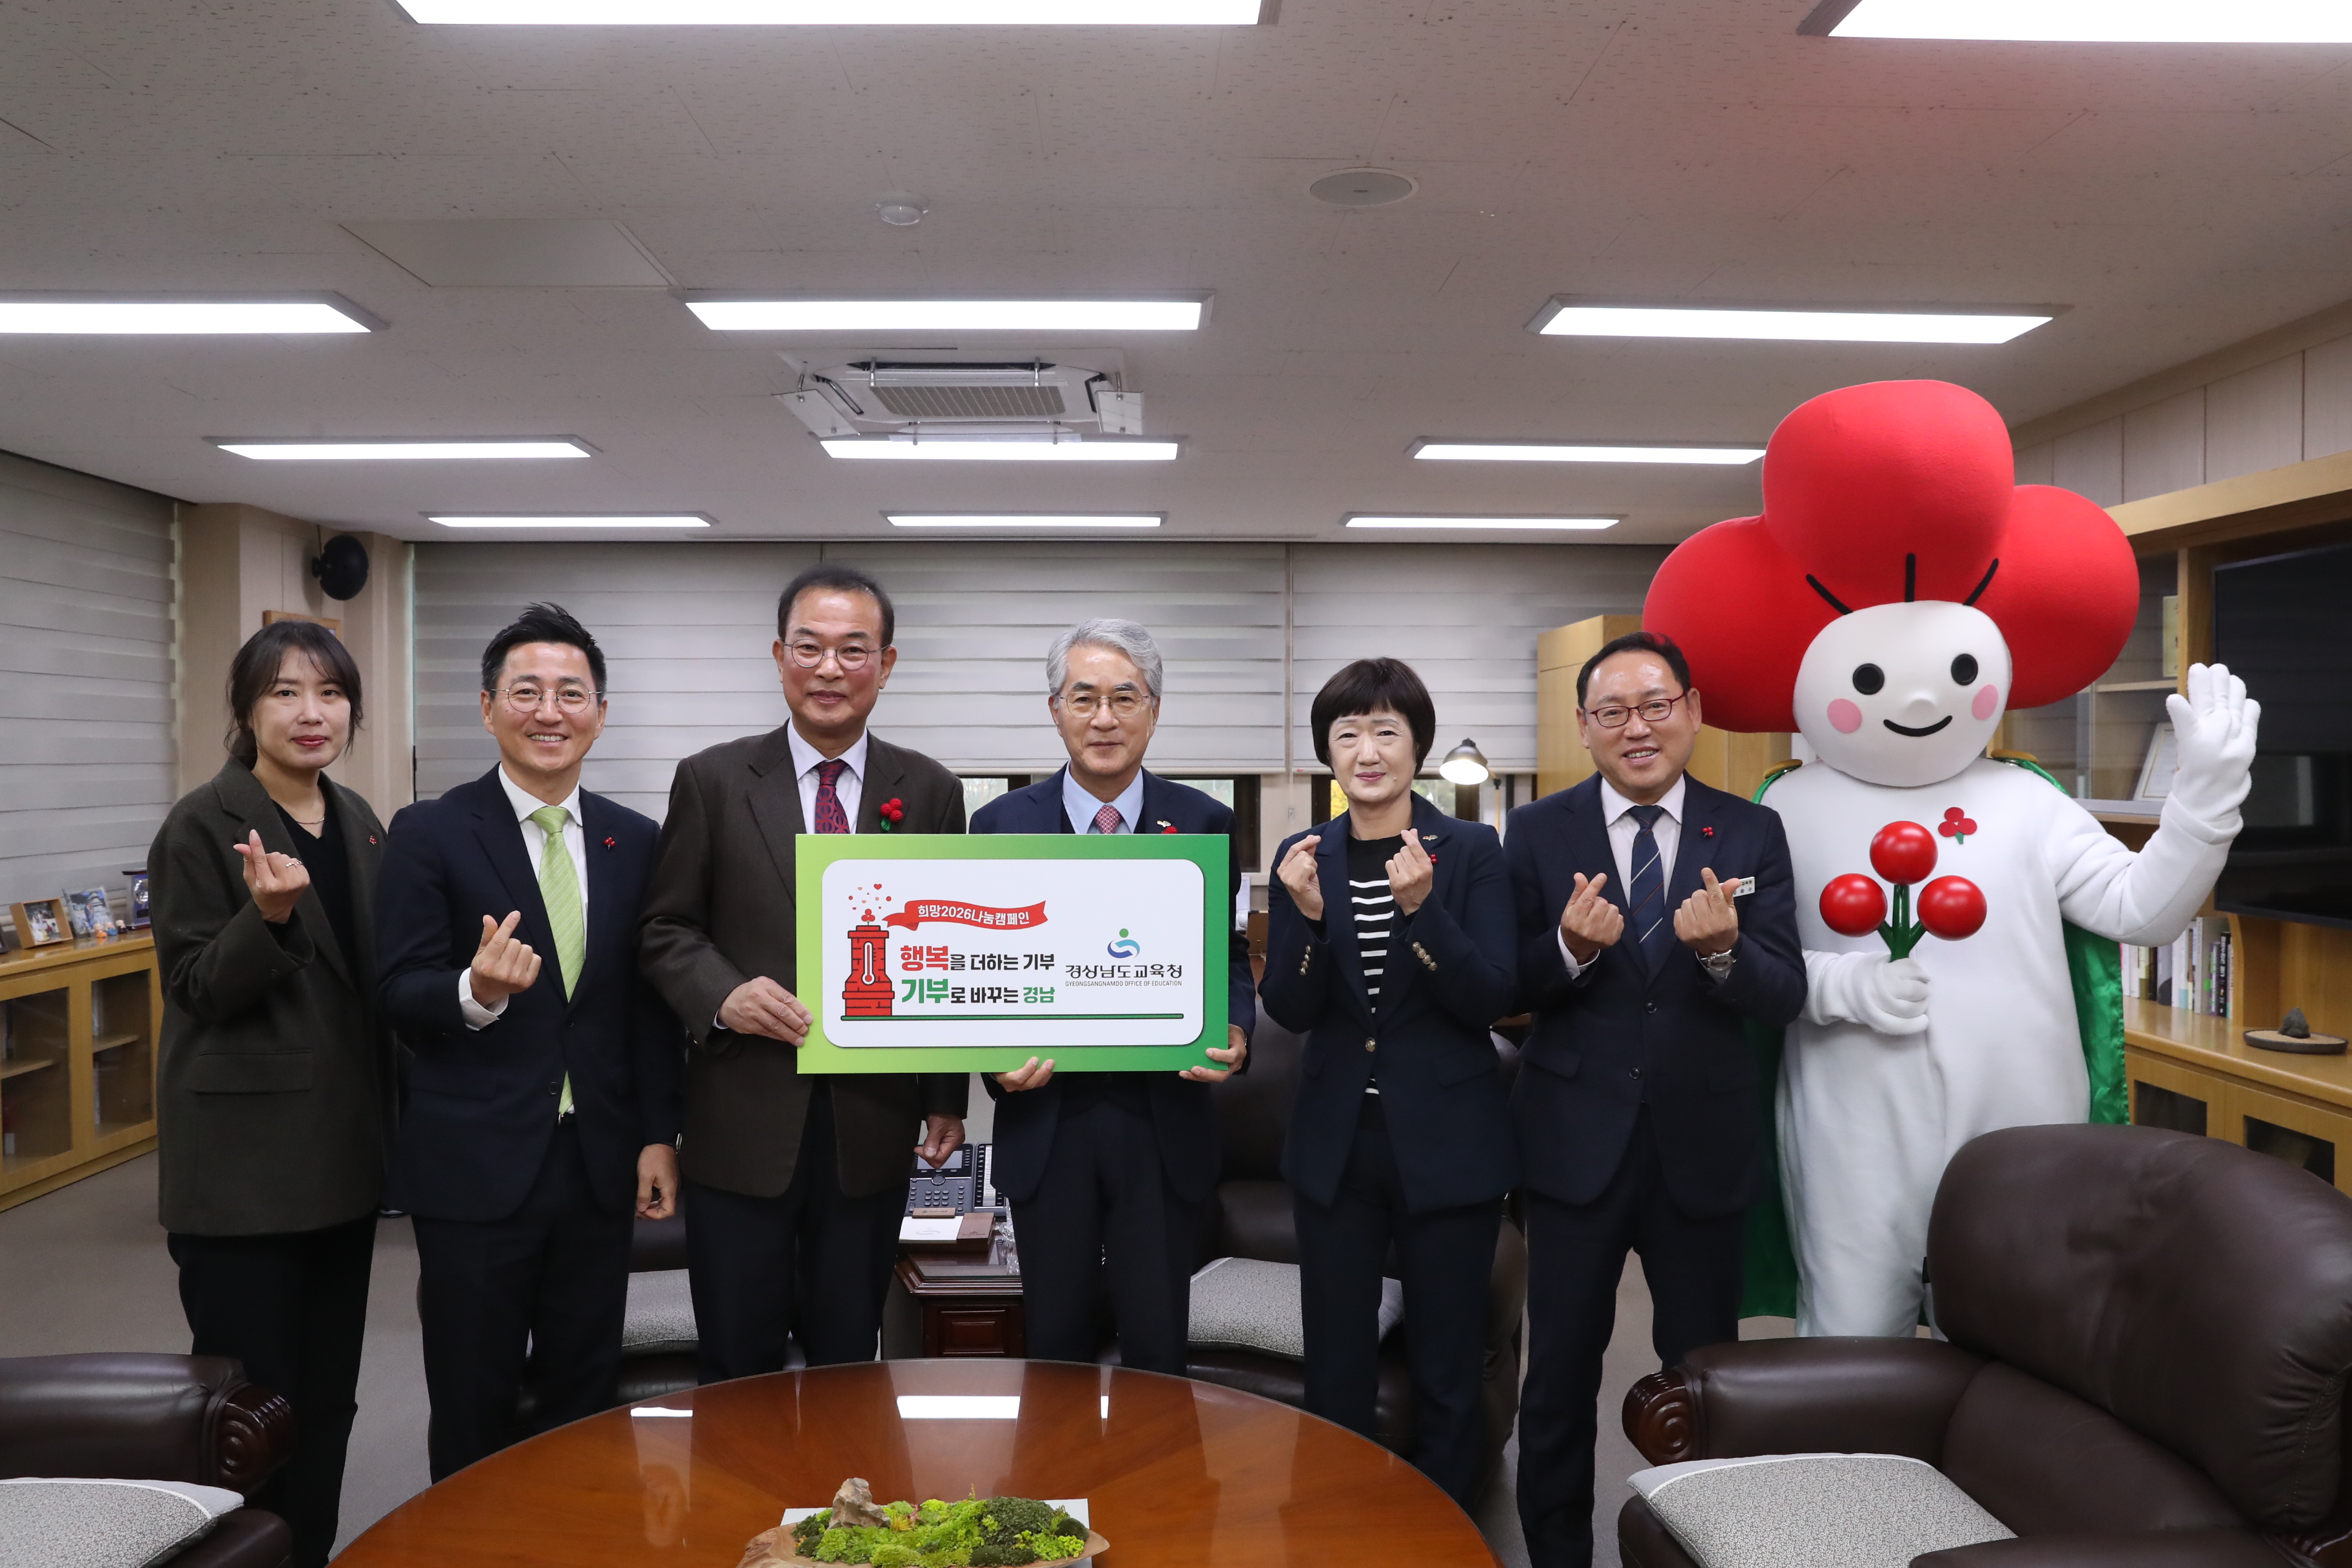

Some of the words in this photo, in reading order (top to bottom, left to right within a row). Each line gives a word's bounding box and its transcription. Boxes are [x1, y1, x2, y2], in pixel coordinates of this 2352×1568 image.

[917, 905, 1030, 926] 희망2026나눔캠페인
[900, 945, 966, 971] 행복을
[970, 953, 1019, 970] 더하는
[1023, 954, 1055, 970] 기부
[1065, 964, 1182, 979] 경상남도교육청
[901, 979, 966, 1004] 기부로
[970, 986, 1019, 1004] 바꾸는
[1023, 986, 1055, 1003] 경남
